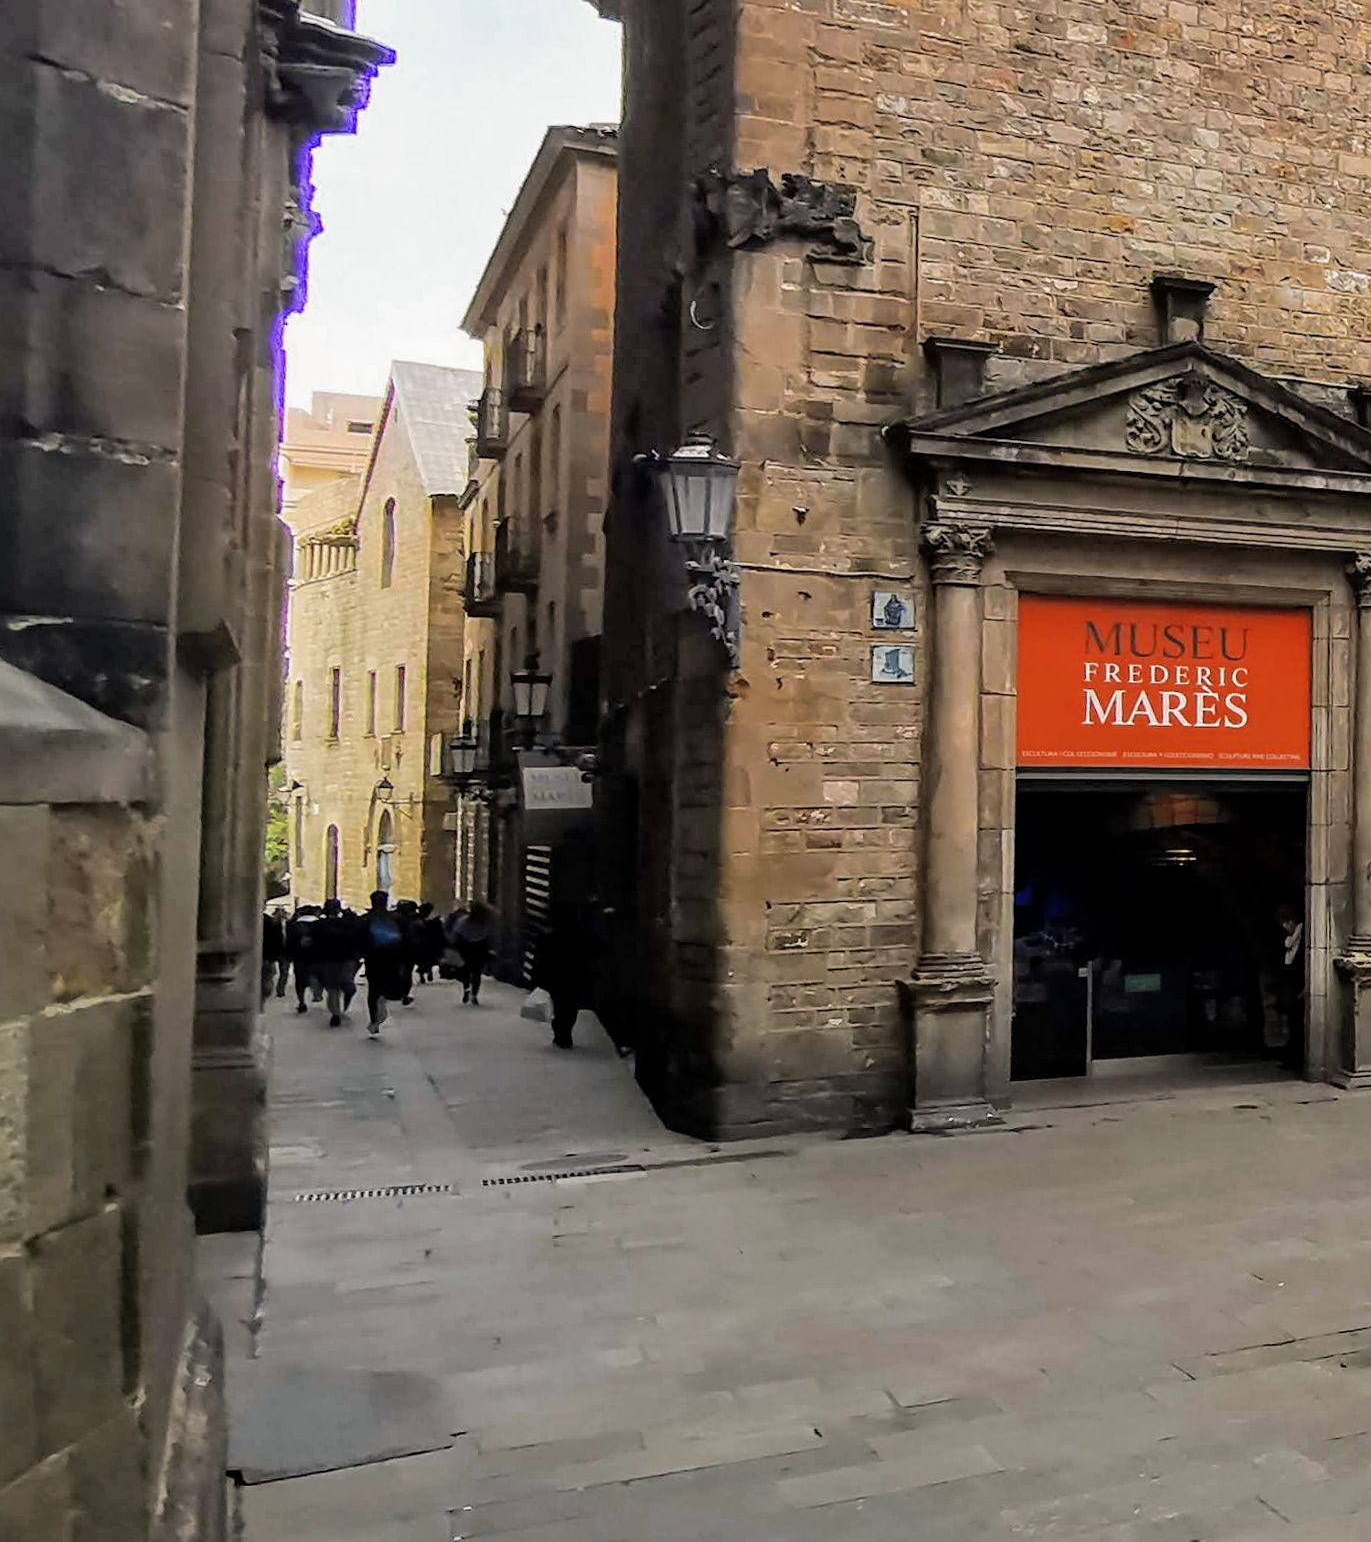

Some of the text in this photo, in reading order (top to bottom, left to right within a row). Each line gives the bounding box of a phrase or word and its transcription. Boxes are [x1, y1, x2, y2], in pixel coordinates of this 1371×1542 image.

[1085, 620, 1249, 661] MUSEU
[1083, 662, 1249, 688] FREDERIC
[1081, 684, 1249, 729] MARÈS
